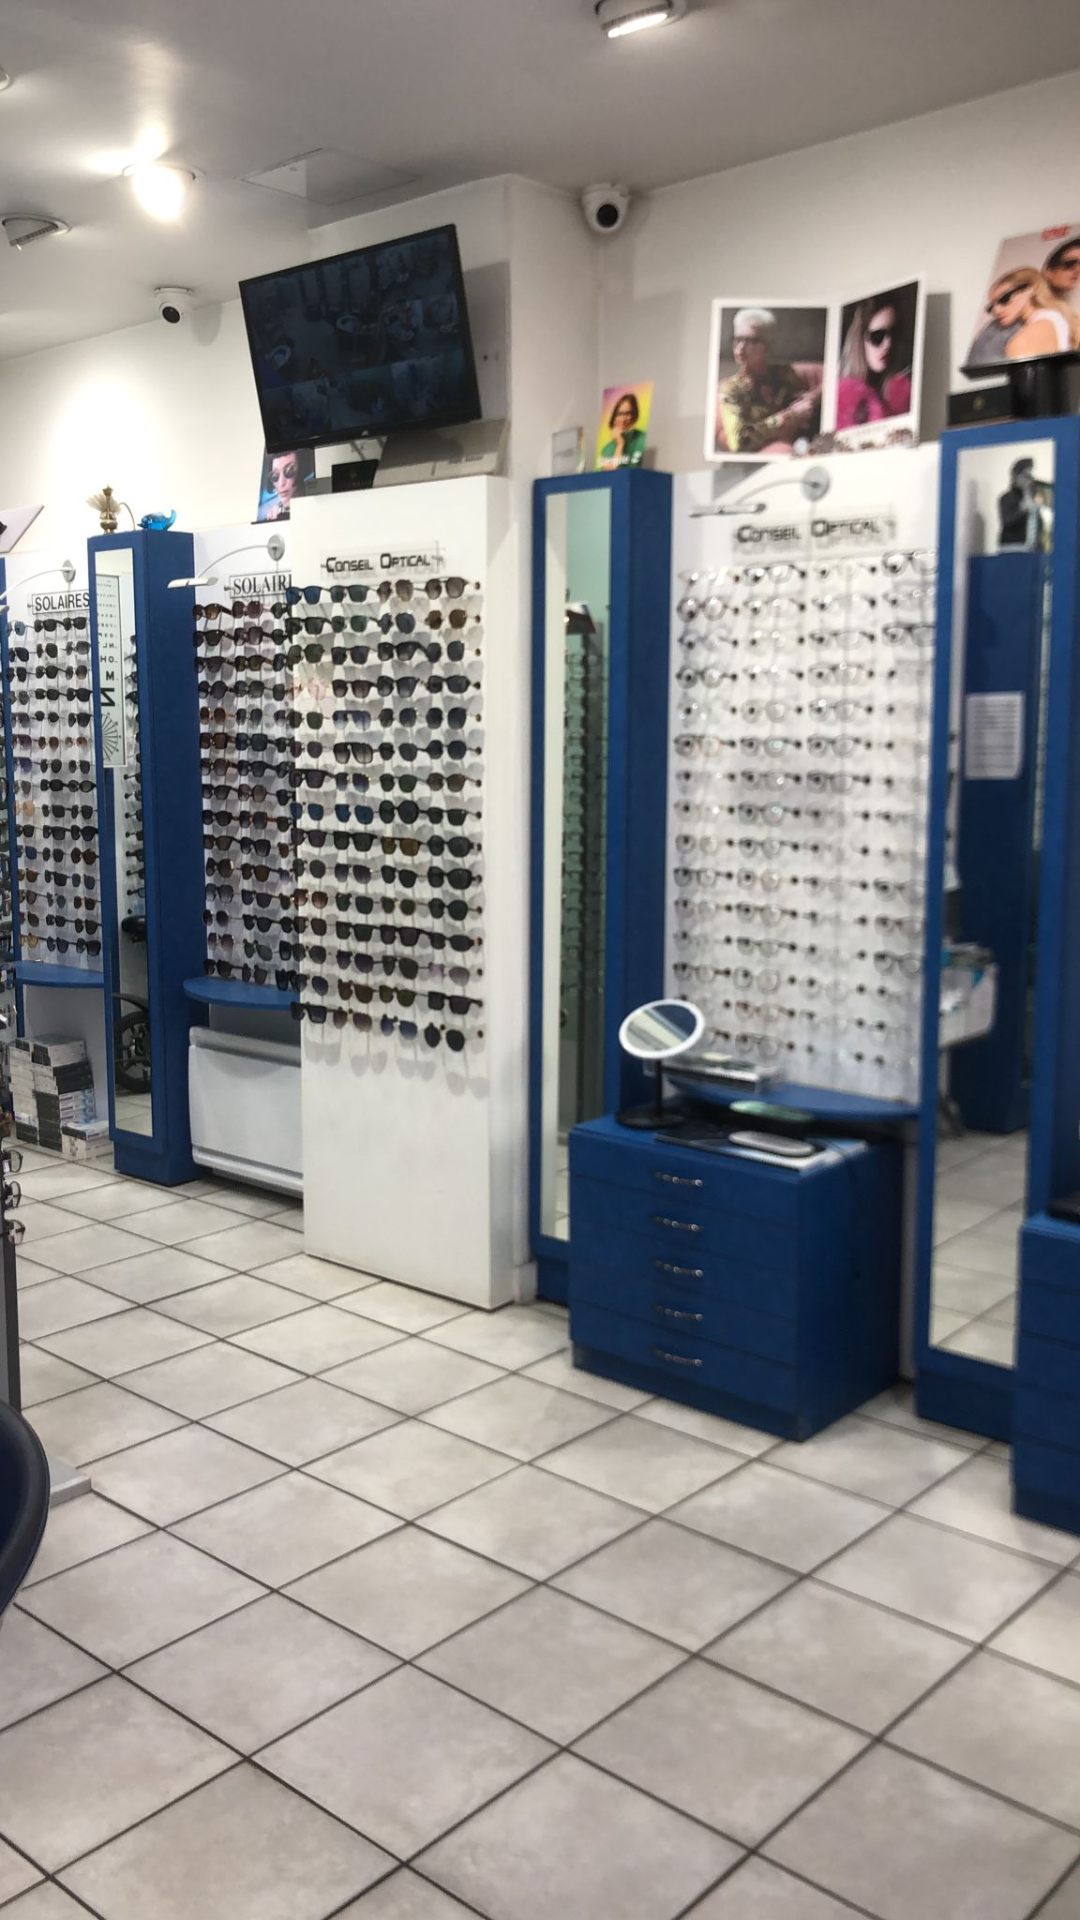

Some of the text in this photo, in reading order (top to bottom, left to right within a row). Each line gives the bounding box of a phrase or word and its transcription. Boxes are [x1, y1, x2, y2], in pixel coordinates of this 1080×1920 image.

[325, 552, 431, 573] CONSEIL OPTICAL
[35, 592, 90, 611] SOLAIRES
